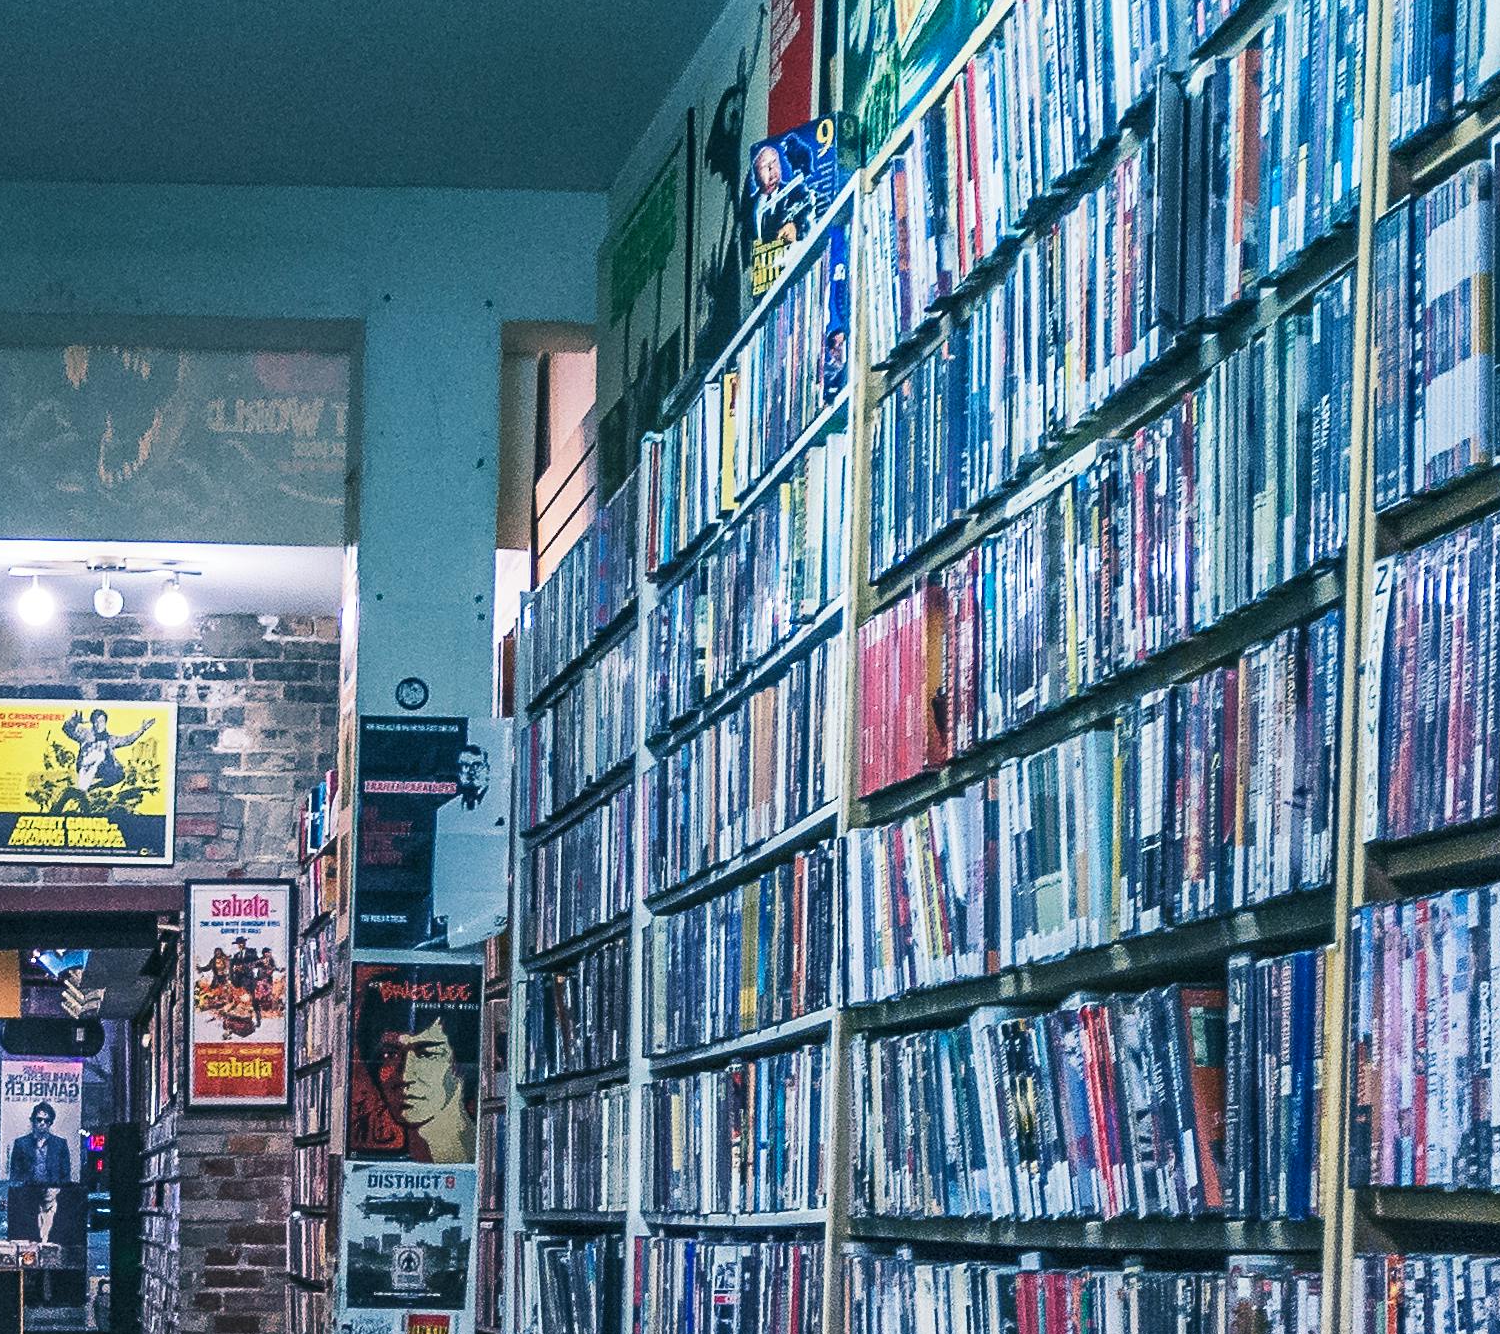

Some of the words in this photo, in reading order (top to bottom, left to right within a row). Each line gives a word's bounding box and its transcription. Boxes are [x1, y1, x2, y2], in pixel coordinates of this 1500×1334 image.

[816, 117, 835, 156] 9
[15, 816, 58, 828] STREET
[7, 829, 60, 845] HONG
[211, 894, 271, 917] sabata
[206, 1056, 273, 1078] sabata
[367, 1173, 439, 1189] DISTRICT
[442, 1174, 455, 1189] 9
